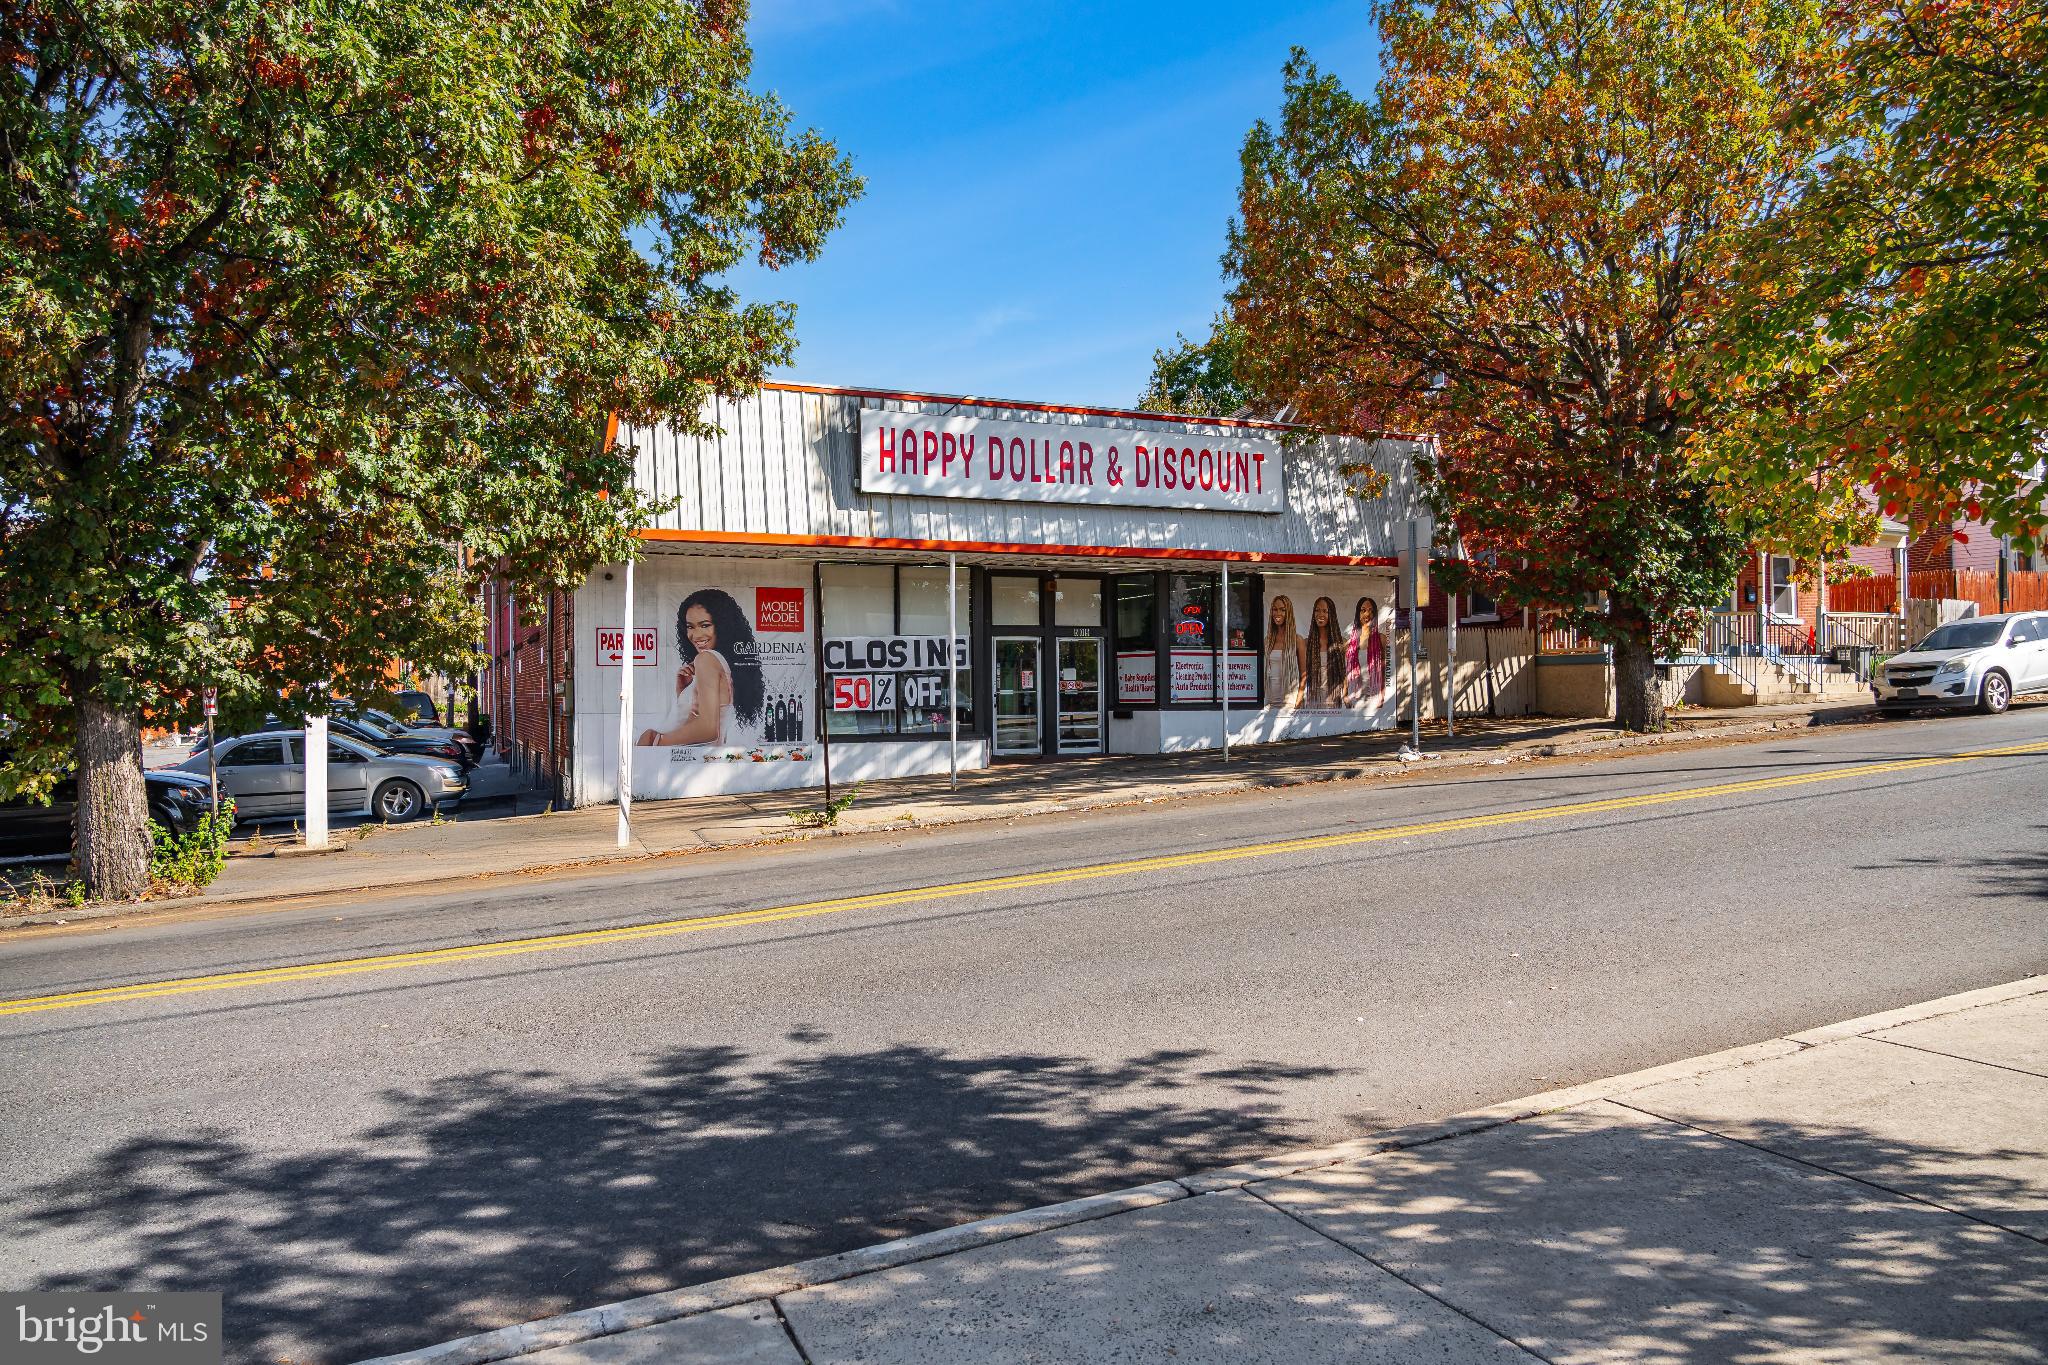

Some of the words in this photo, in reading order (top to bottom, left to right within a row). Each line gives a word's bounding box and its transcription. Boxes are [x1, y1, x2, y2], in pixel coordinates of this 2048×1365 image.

[878, 426, 975, 479] HAPPY
[988, 436, 1094, 486] DOLLAR
[1106, 445, 1124, 487] &
[1135, 445, 1265, 495] DISCOUNT
[761, 601, 800, 612] MODEL
[761, 612, 800, 623] MODEL
[1175, 623, 1204, 635] OPEN
[600, 633, 654, 651] PARING
[733, 641, 805, 655] GARDENIA
[824, 639, 968, 670] CLOSING
[904, 676, 942, 708] OFF
